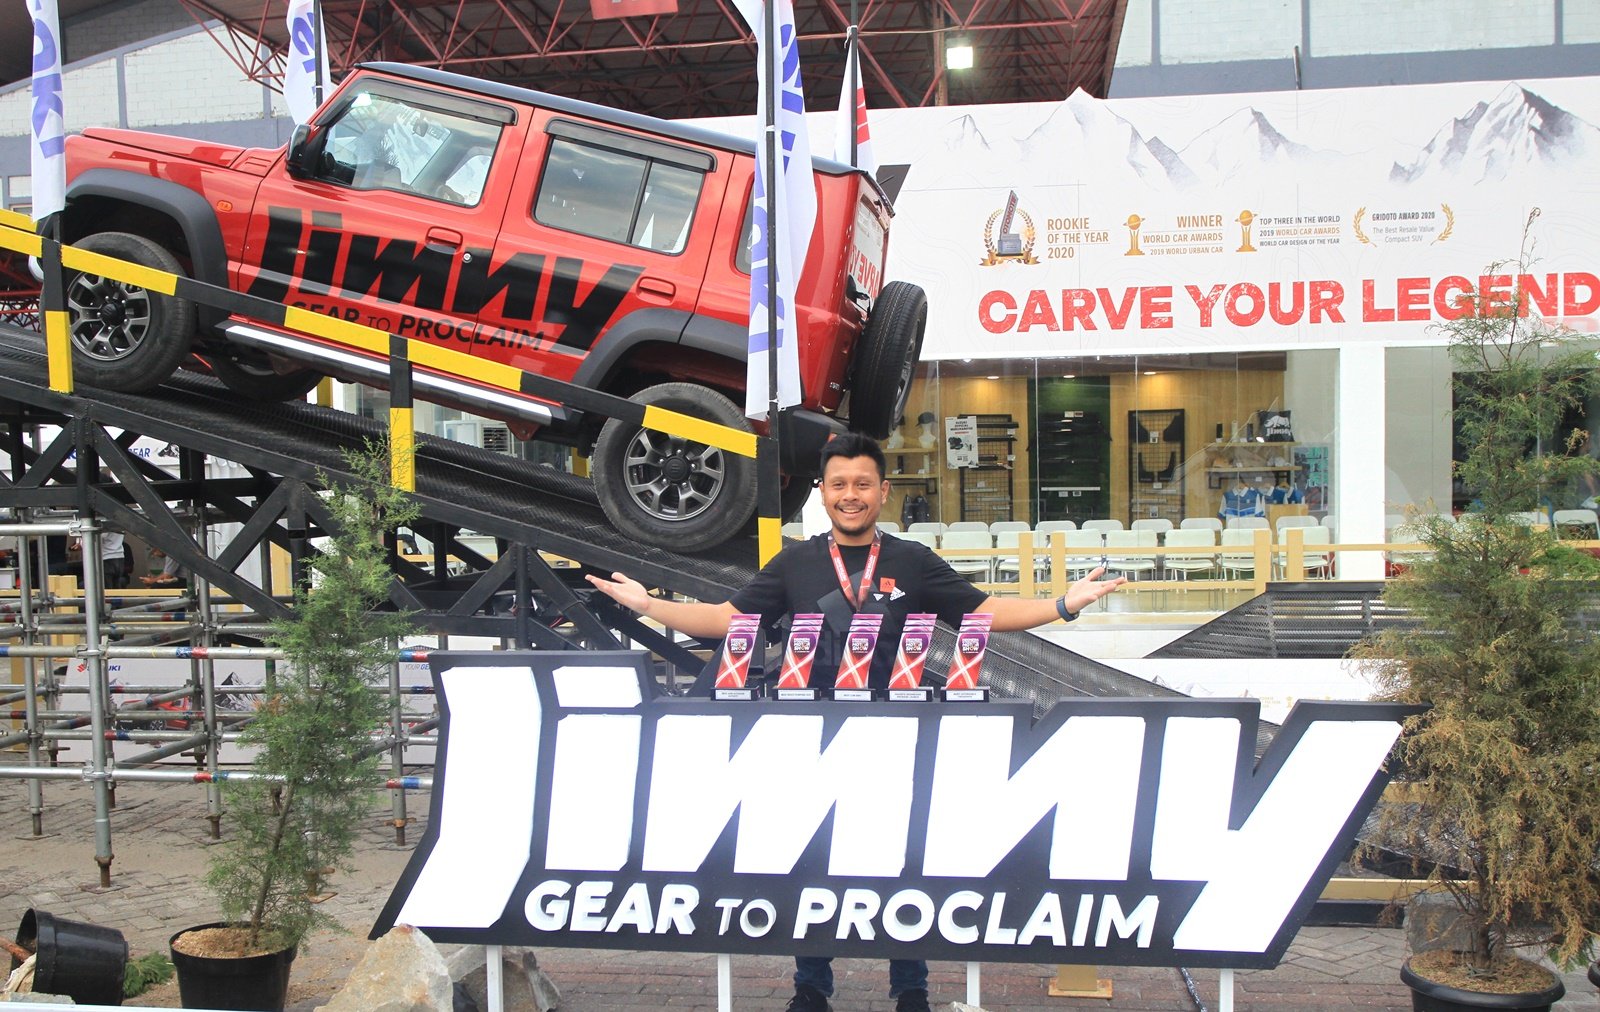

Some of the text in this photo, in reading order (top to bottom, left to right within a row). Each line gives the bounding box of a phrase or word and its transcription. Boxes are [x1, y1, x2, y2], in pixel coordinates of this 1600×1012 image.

[1176, 215, 1223, 228] WINNER
[1274, 217, 1293, 225] THREE
[1304, 216, 1316, 224] THE
[1318, 215, 1340, 224] WORLD
[1372, 211, 1436, 222] GRIDOTO AWARD 2020
[1047, 218, 1090, 231] ROOKIE
[1373, 225, 1435, 235] The Best Resale Value
[1047, 231, 1109, 244] OF THE YEAR
[1143, 232, 1223, 244] WORLD CAR AWARDS
[1276, 229, 1298, 237] WORLD
[1300, 228, 1312, 236] CAR
[1314, 227, 1340, 235] AWARDS
[1385, 234, 1423, 245] Compact SUV
[1047, 247, 1074, 259] 2020
[1211, 246, 1223, 254] CAR
[979, 272, 1600, 334] CARVE YOUR LEGEND
[367, 316, 390, 332] TO
[400, 315, 545, 350] PROCLAIM
[524, 879, 1160, 949] GEAR TO PROCLAIM
